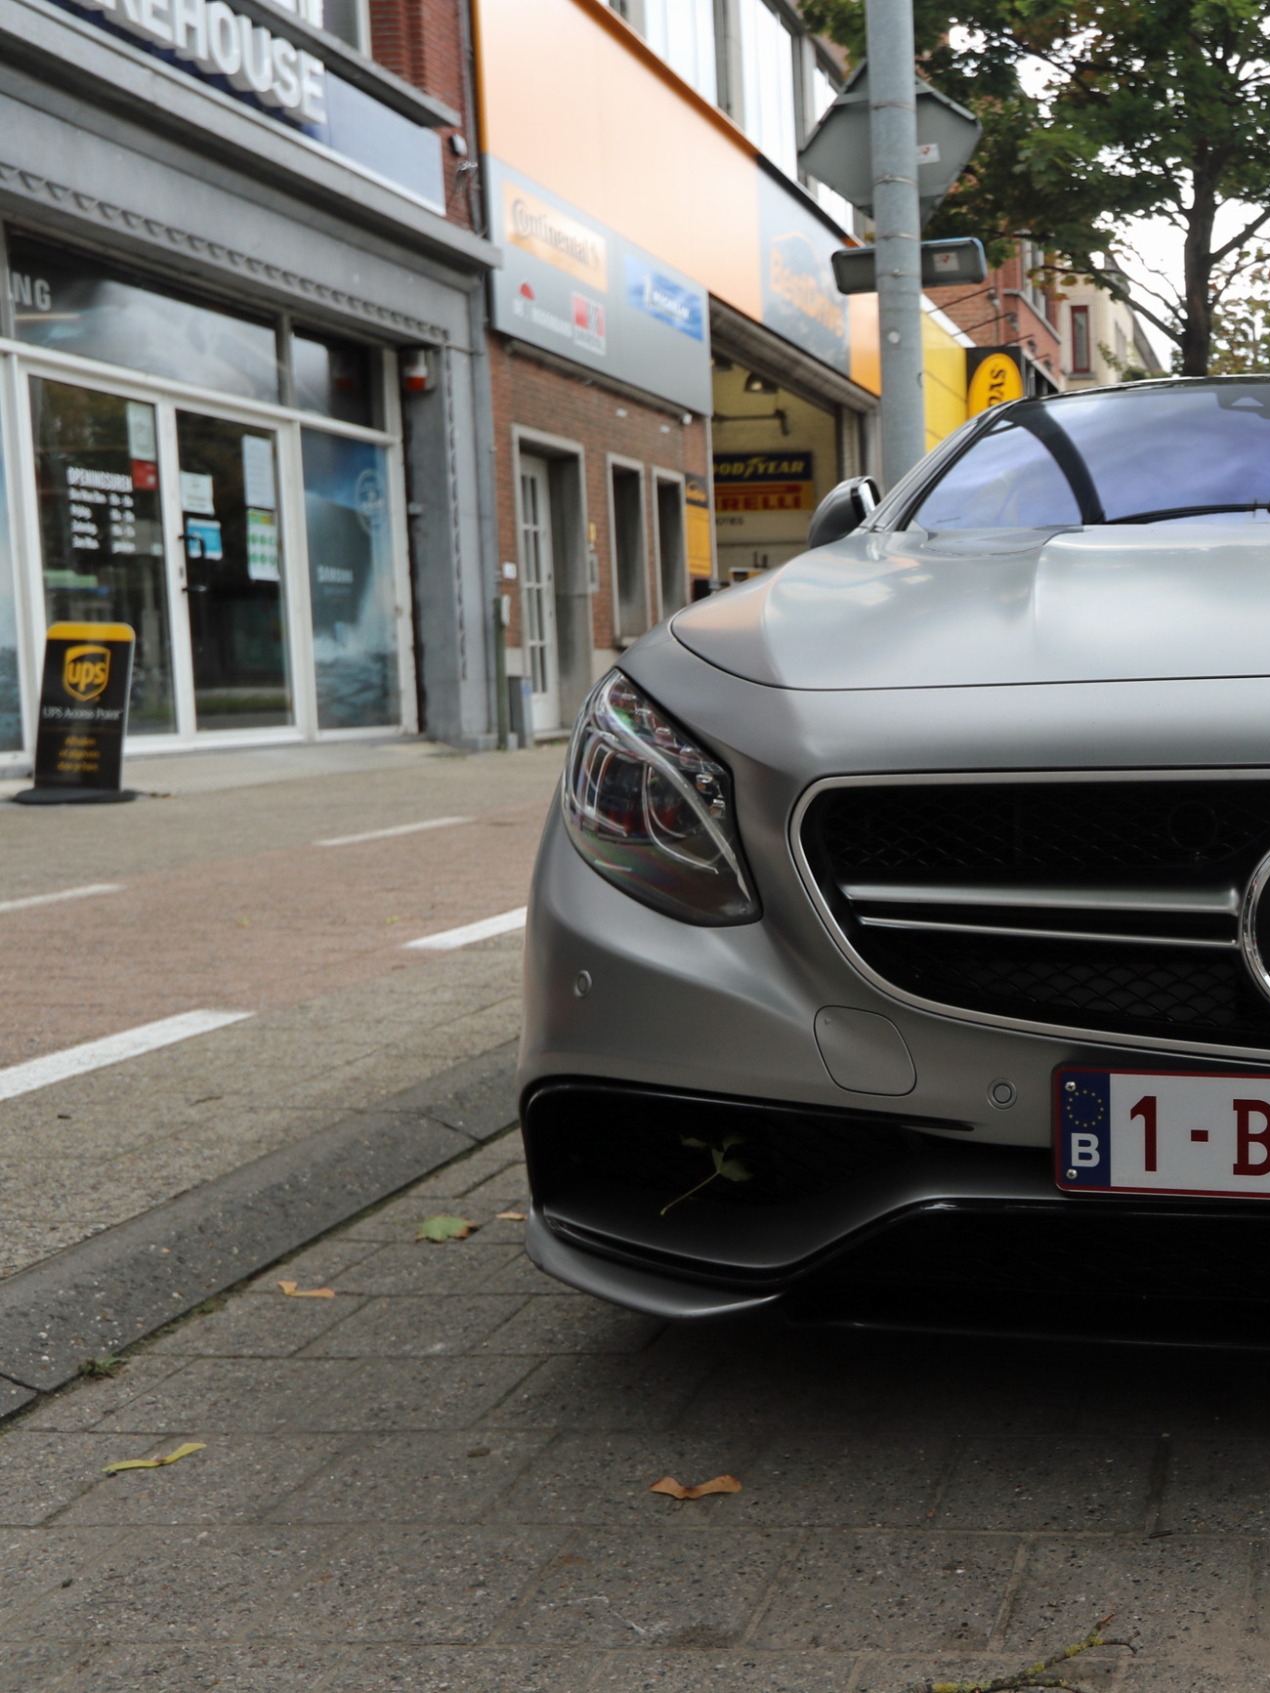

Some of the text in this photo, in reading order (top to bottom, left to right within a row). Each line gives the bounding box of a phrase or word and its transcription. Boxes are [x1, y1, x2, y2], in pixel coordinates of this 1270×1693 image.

[512, 198, 592, 268] Continental
[67, 660, 107, 692] ups
[1070, 1132, 1100, 1168] B
